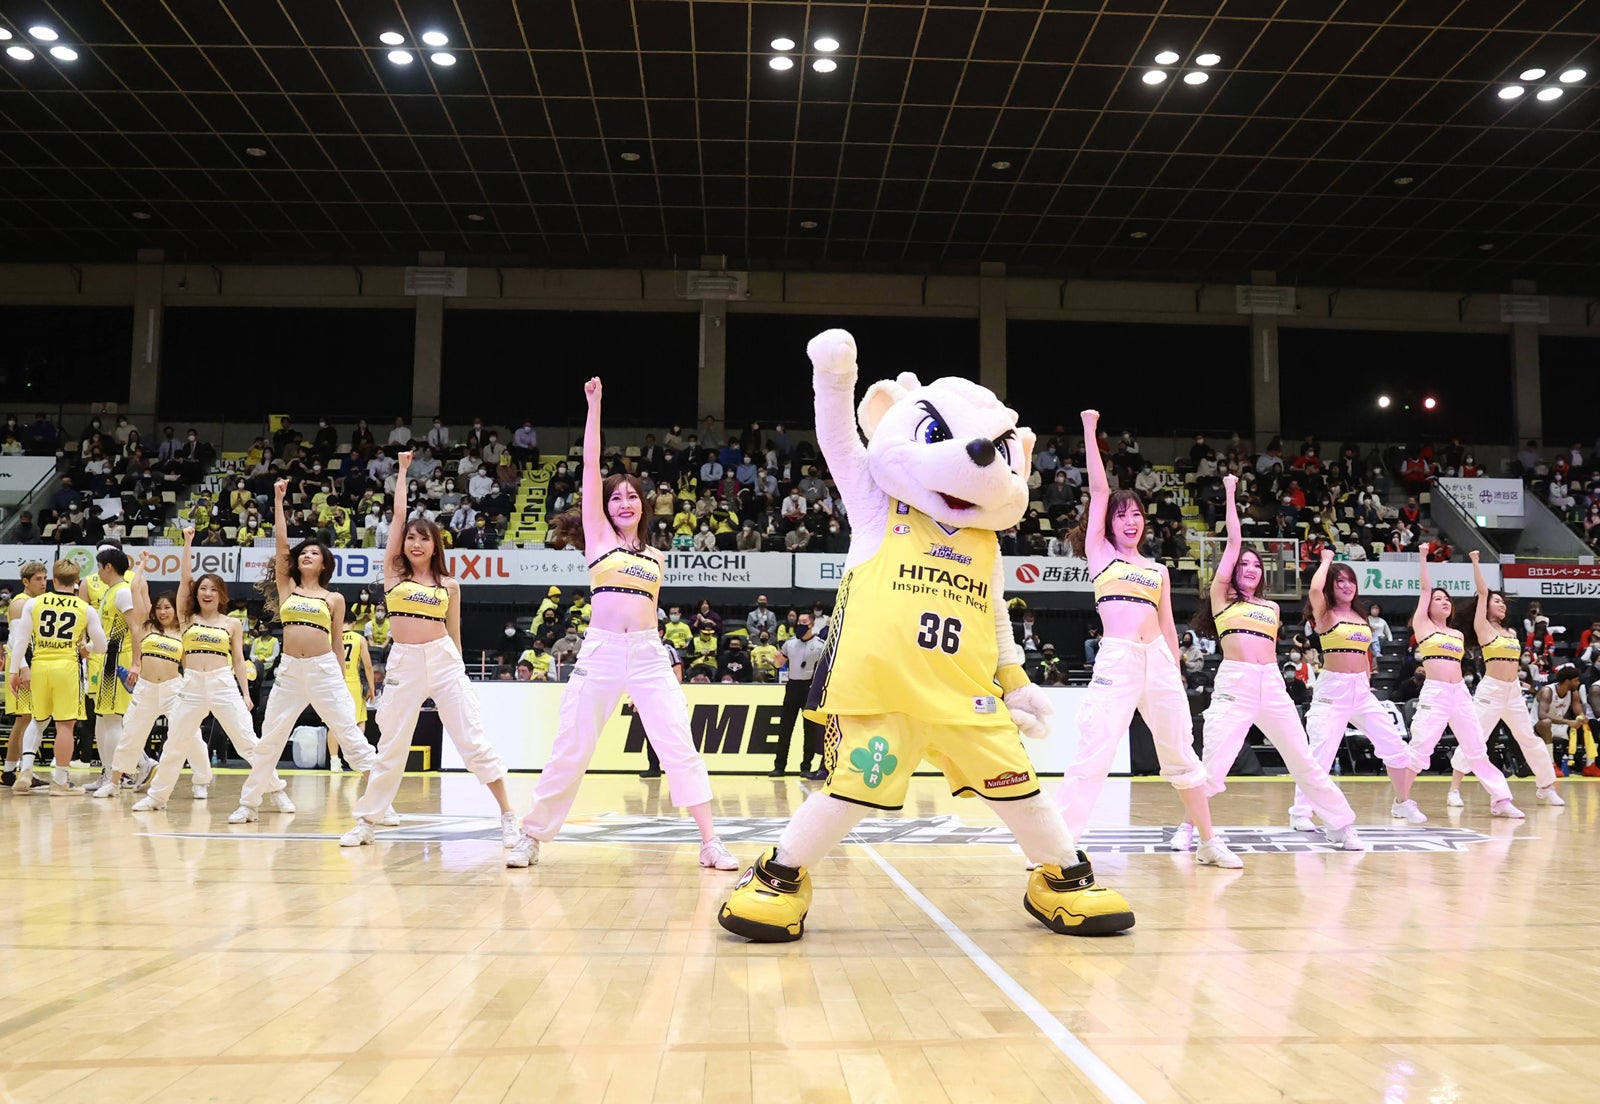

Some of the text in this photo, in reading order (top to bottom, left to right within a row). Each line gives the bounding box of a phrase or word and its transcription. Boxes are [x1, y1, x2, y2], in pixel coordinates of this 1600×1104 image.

[449, 554, 510, 580] IXIL
[520, 563, 590, 573] いつもを、幸せ
[663, 571, 751, 583] spire the Next
[1528, 567, 1600, 577] 日立エレベーター・エ
[899, 564, 988, 599] HITACHI
[1436, 580, 1471, 591] ESTATE
[1541, 582, 1600, 595] 日立ビルシ
[43, 597, 79, 608] LIXIL
[892, 581, 988, 613] Inspire the Next
[39, 609, 76, 640] 32
[917, 612, 962, 655] 36
[621, 703, 783, 754] TME
[869, 741, 884, 784] NOAR
